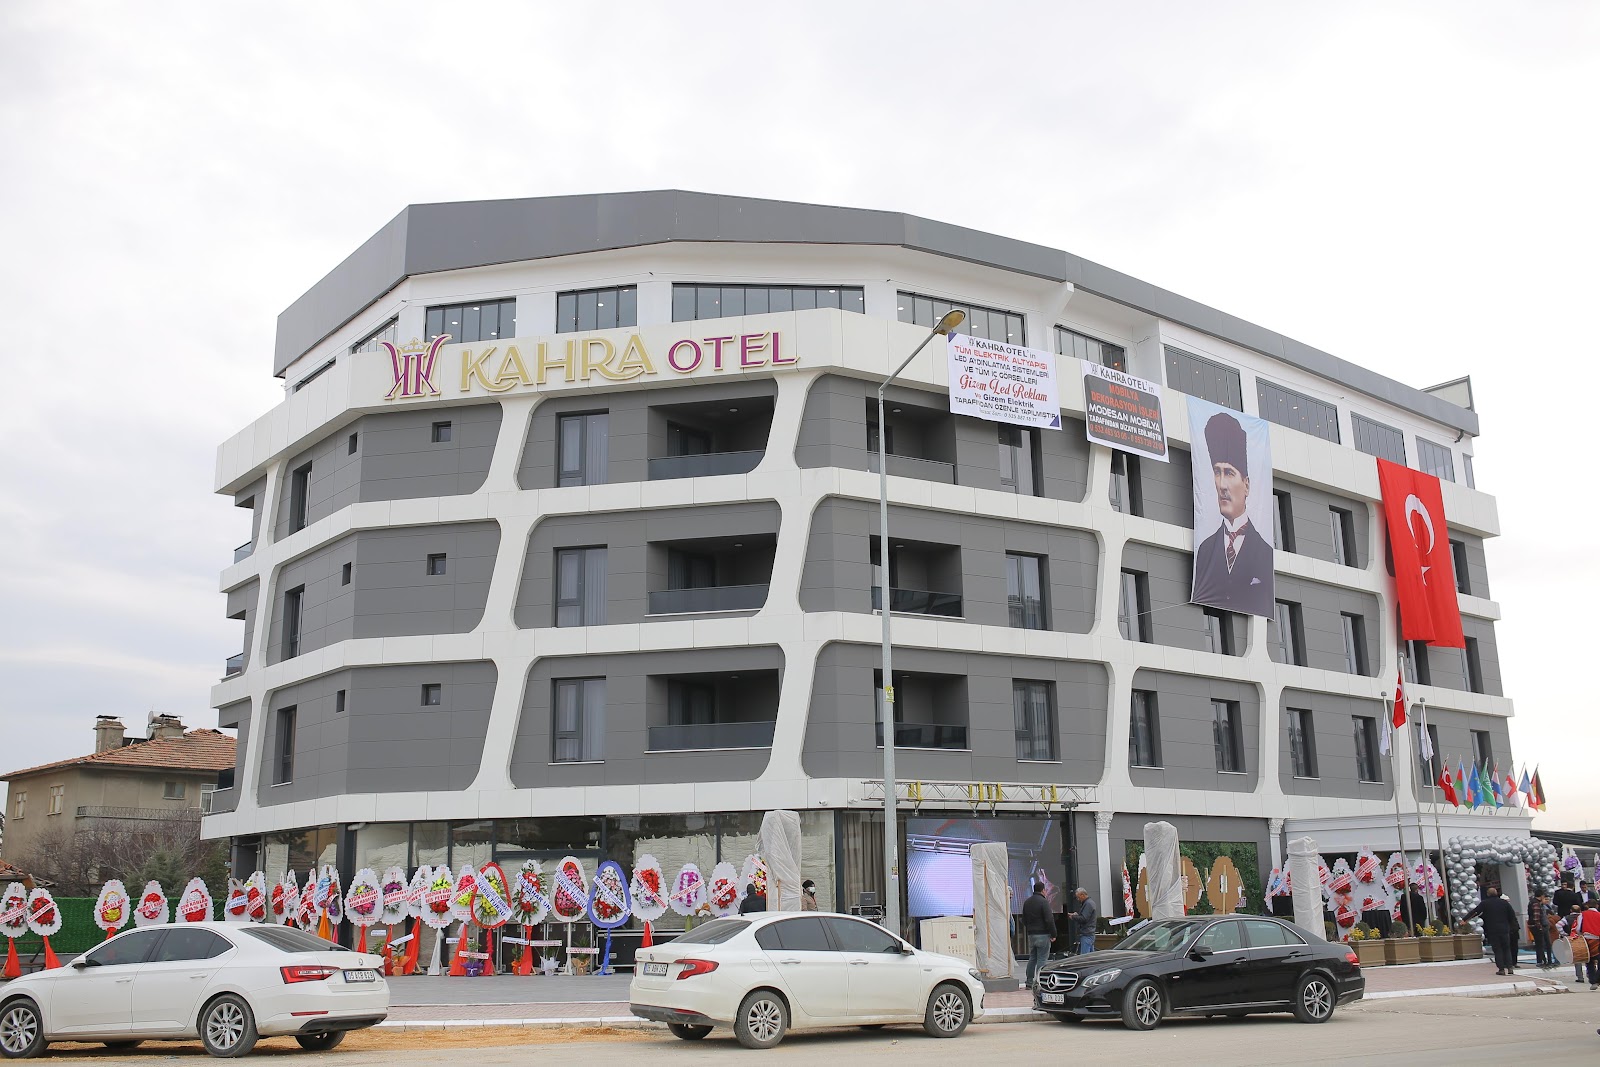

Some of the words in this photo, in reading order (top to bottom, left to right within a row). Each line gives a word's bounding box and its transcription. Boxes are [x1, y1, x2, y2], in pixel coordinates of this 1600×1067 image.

[954, 345, 972, 354] TÜM
[976, 341, 1005, 352] KAHRA
[459, 333, 659, 393] KAHRA
[667, 331, 801, 375] OTEL
[954, 354, 967, 362] LED
[1100, 367, 1127, 384] KAHRA
[960, 374, 987, 391] Gizem
[989, 378, 1010, 394] Led
[1012, 383, 1048, 402] Reklam
[983, 394, 1006, 404] Gizem
[1008, 398, 1034, 408] Elektrik
[1091, 390, 1137, 412] DEKORASYON
[1089, 403, 1128, 422] MODESAN
[1130, 415, 1160, 432] MOBİLYA
